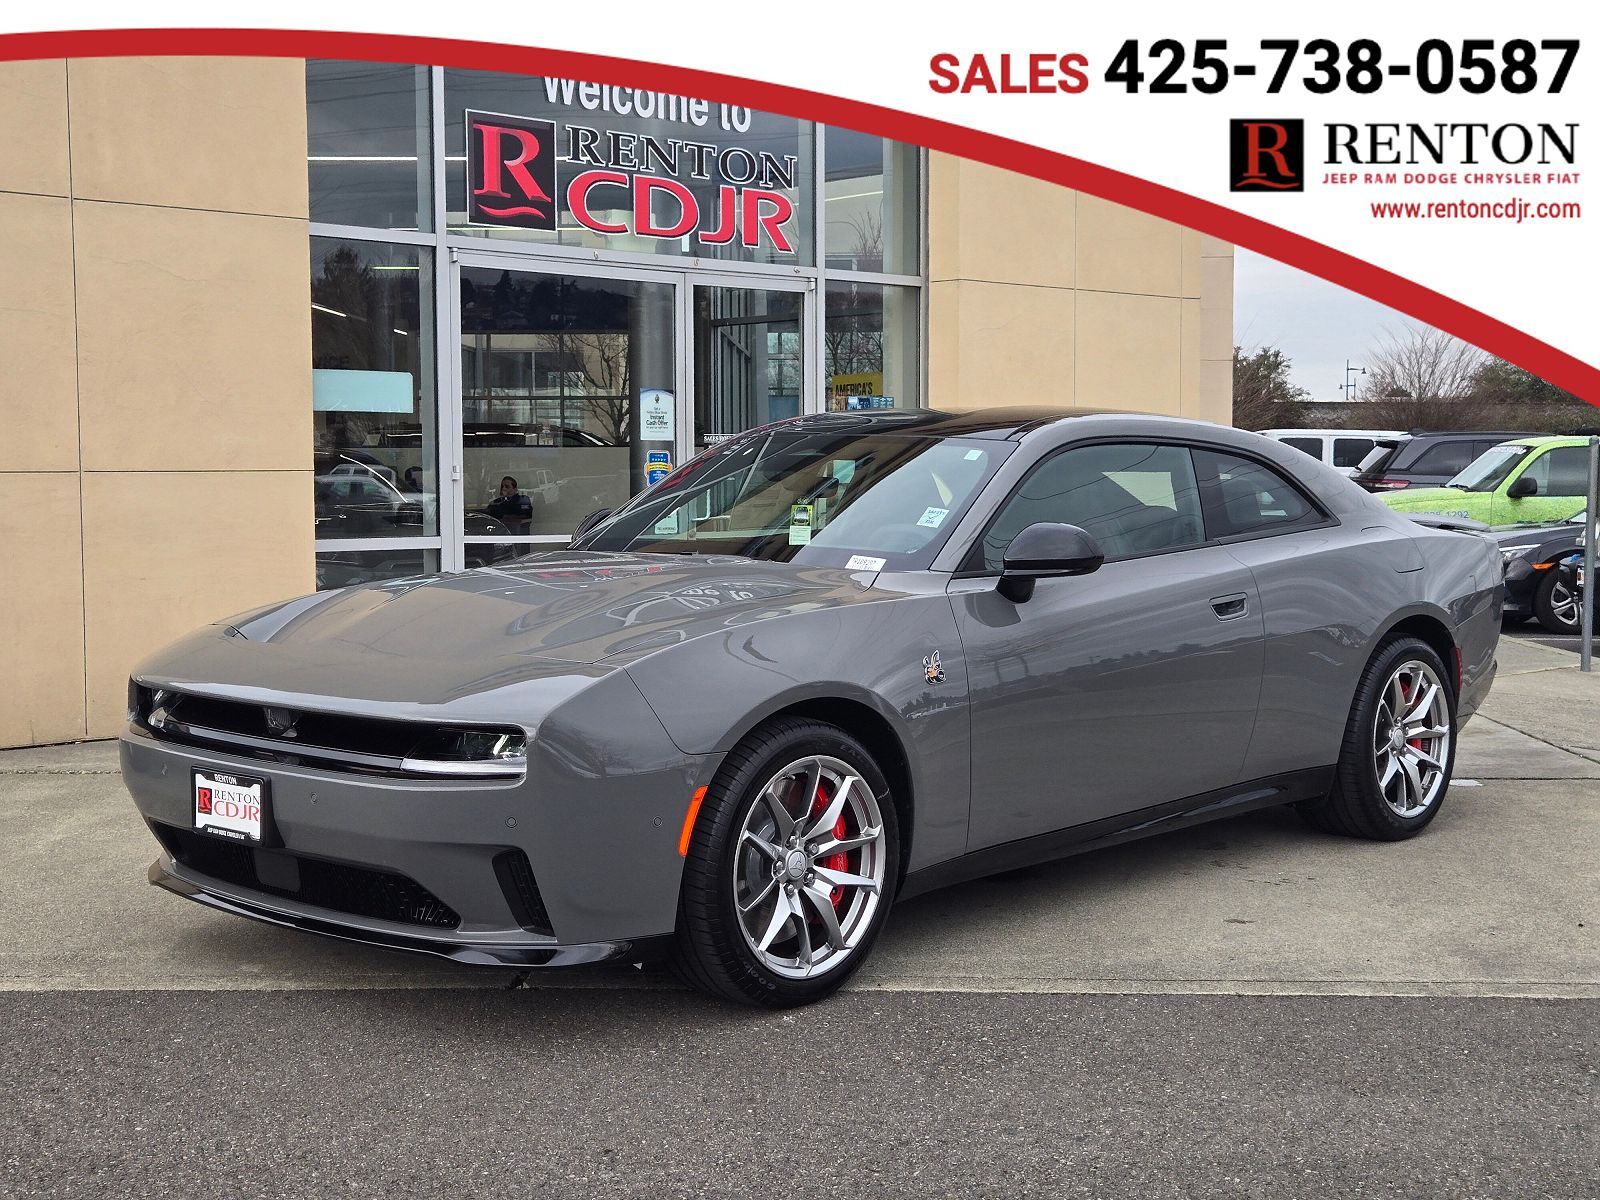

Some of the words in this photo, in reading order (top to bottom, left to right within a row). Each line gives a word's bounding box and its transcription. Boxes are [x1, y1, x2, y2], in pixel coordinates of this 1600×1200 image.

[544, 75, 710, 127] Welcome
[718, 101, 752, 133] to
[565, 124, 798, 190] RENTON
[566, 169, 796, 254] CDJR
[835, 382, 873, 397] AMERICA'S
[214, 789, 259, 805] RENTON
